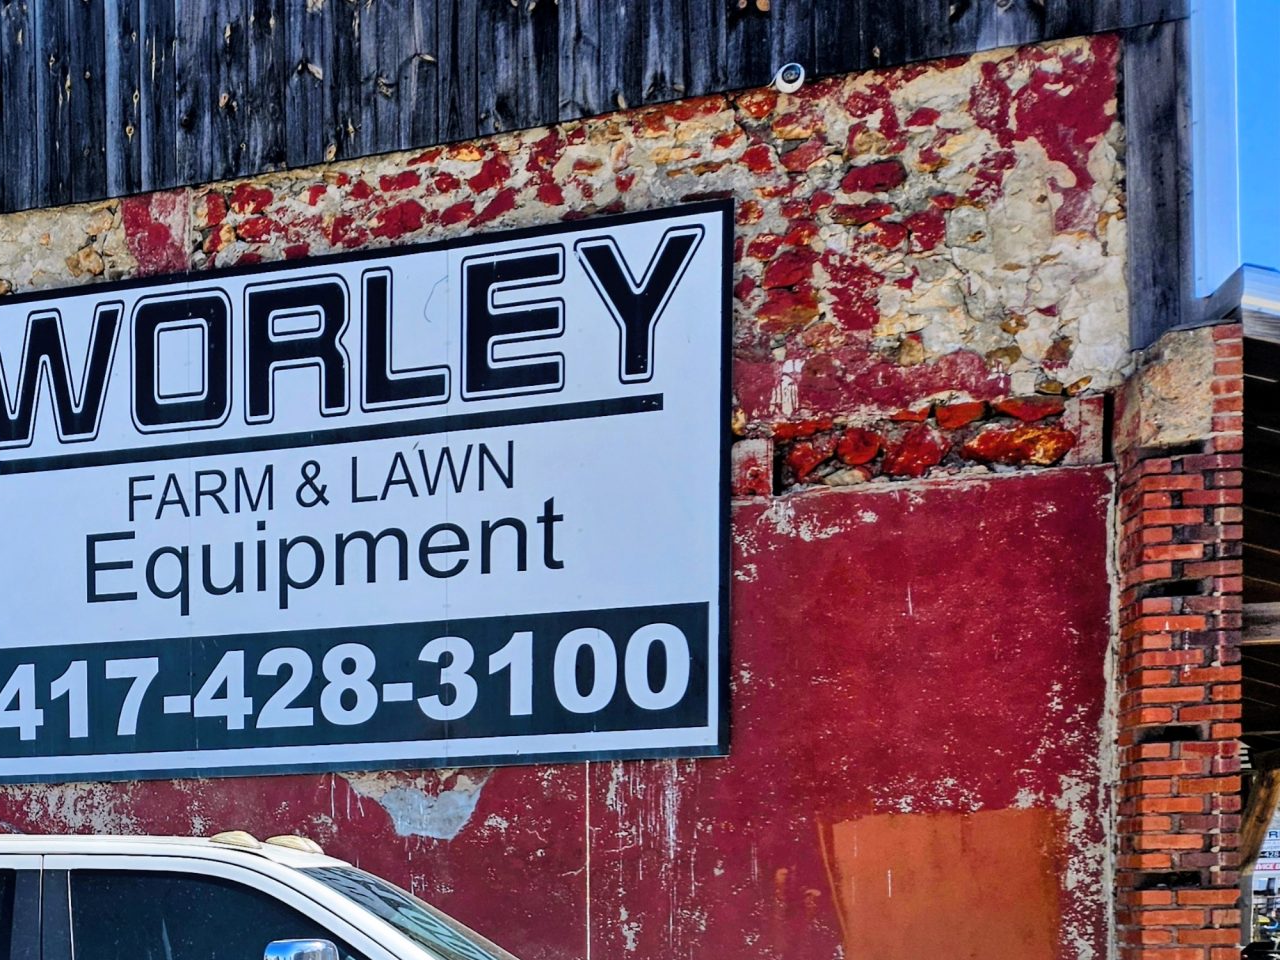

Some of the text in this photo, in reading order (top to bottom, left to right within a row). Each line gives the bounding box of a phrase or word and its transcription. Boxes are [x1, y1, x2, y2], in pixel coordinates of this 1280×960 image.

[128, 441, 516, 521] FARM & LAWN
[86, 498, 564, 617] Equipment
